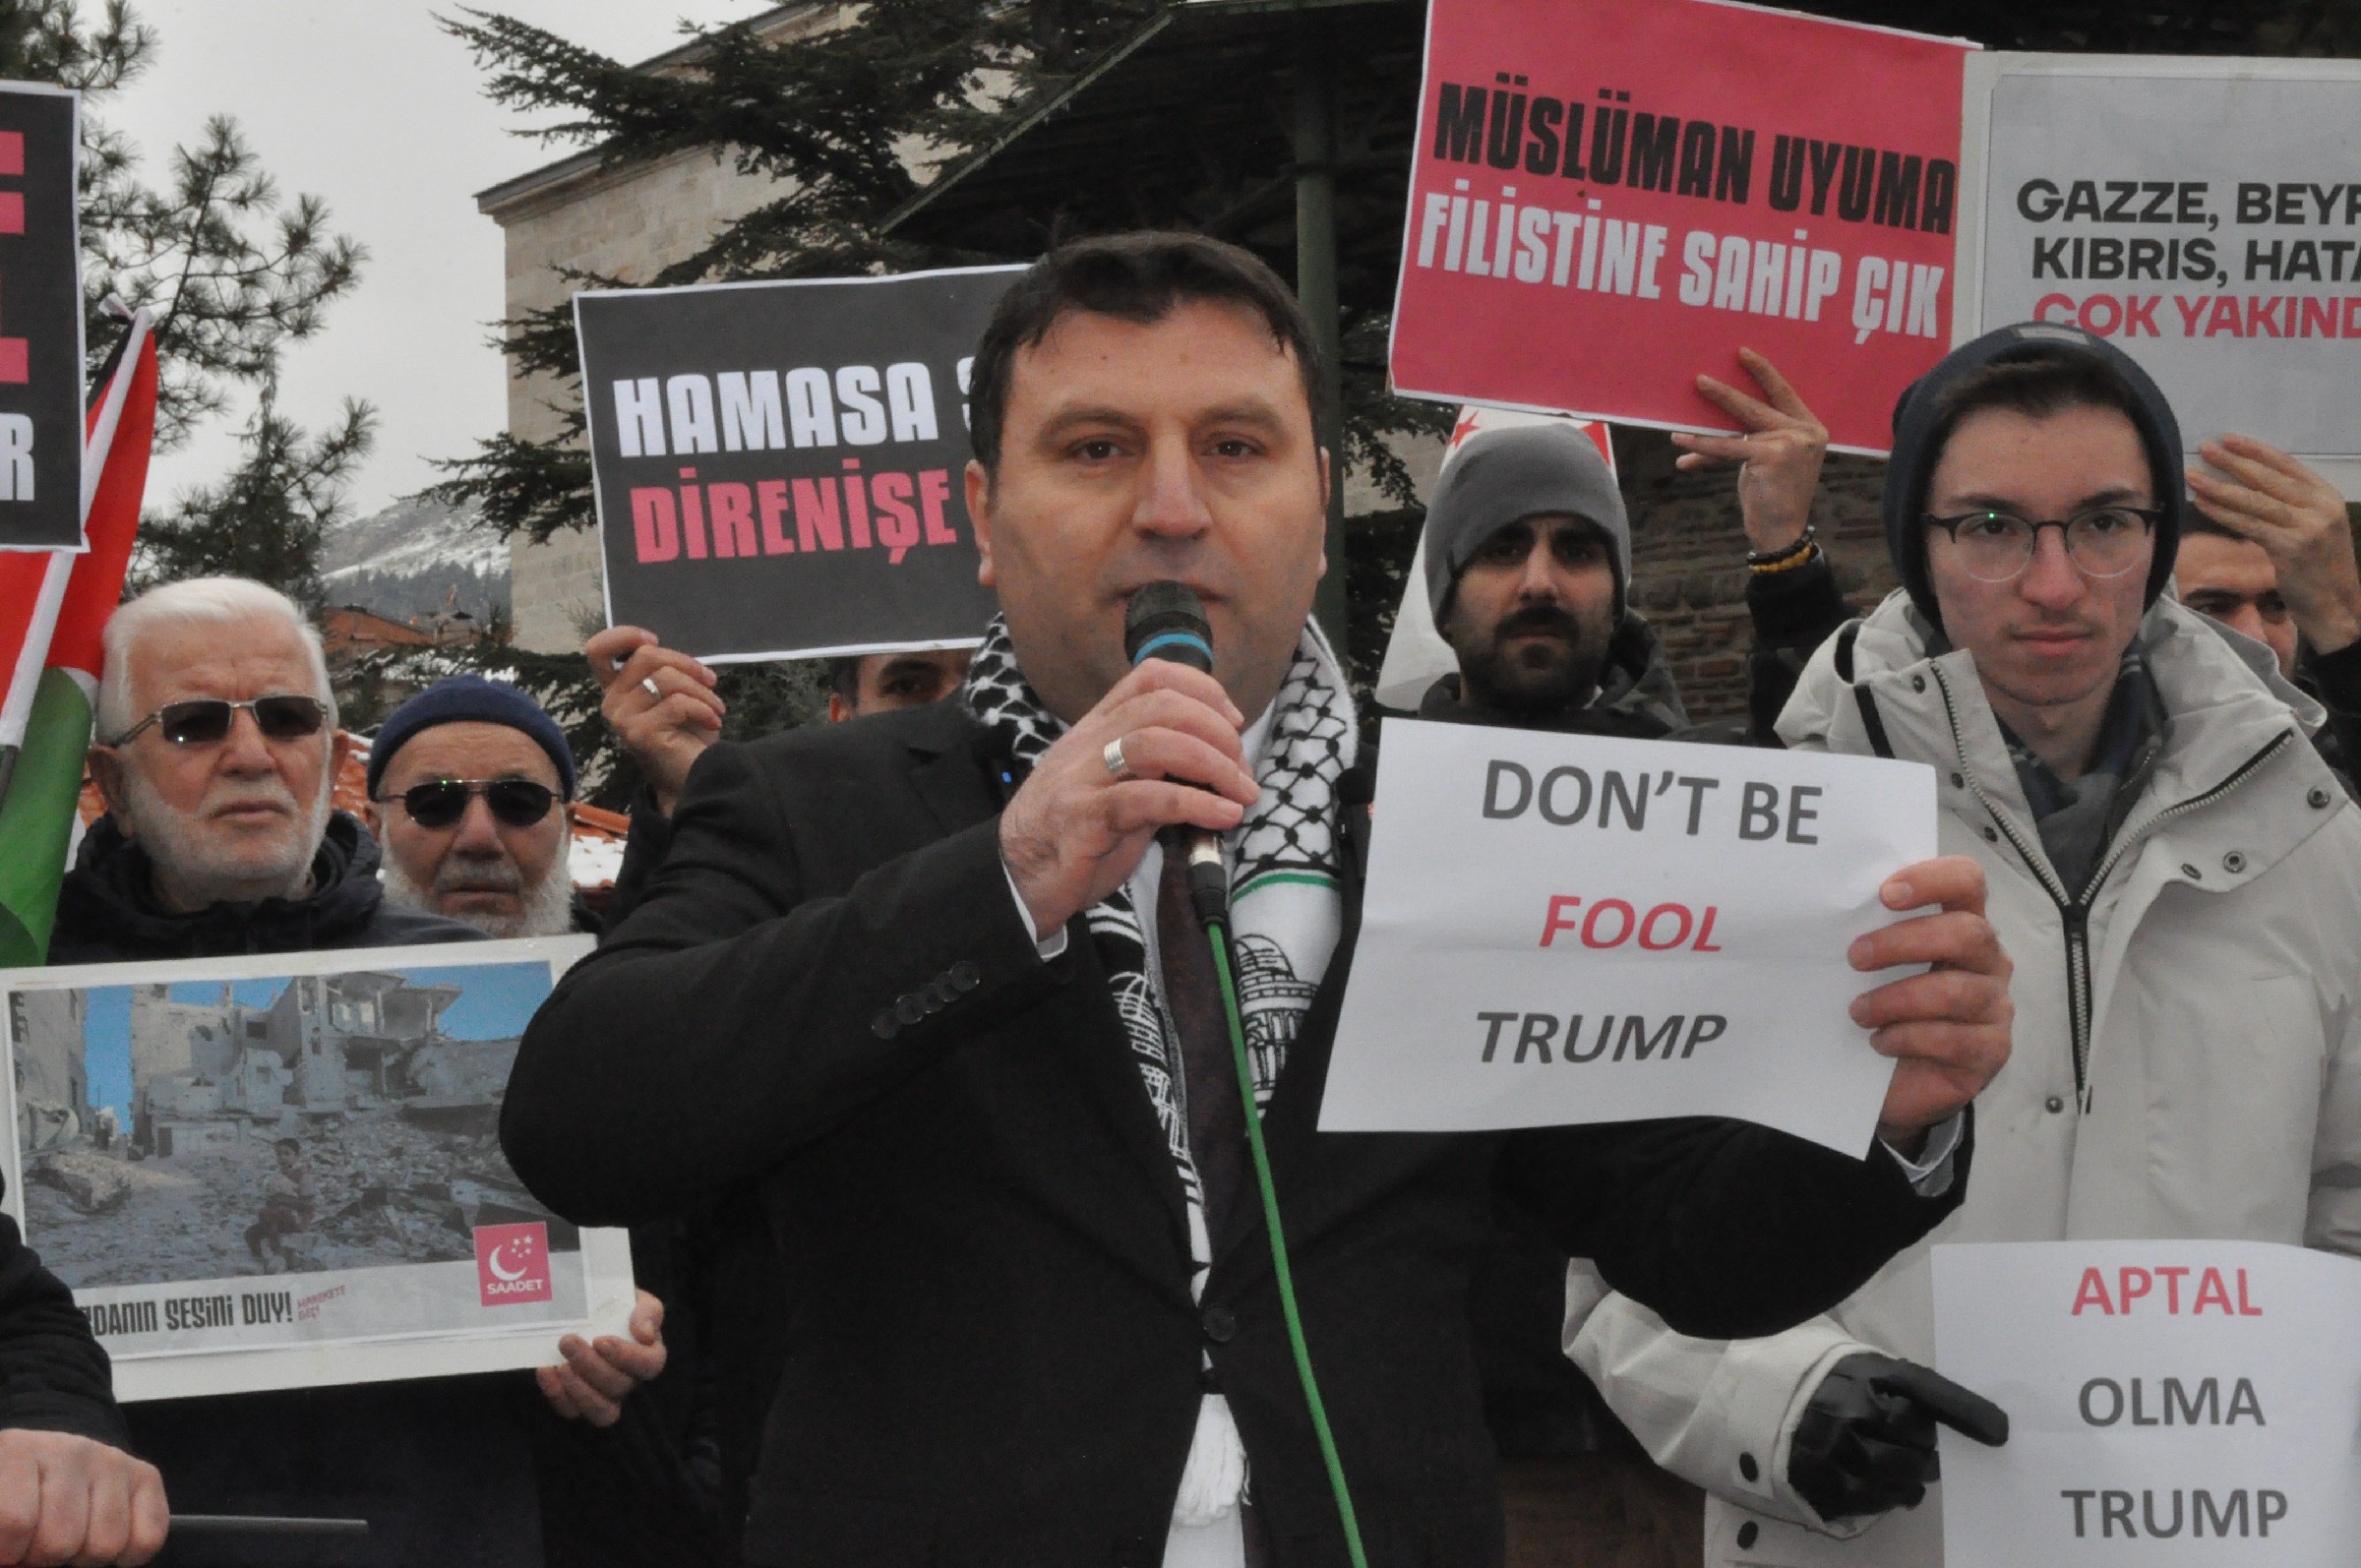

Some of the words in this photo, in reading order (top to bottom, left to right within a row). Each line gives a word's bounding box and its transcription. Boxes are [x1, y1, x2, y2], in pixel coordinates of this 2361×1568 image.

[1433, 72, 1756, 205] MÜSLÜMAN
[1769, 134, 1957, 235] UYUMA
[2017, 178, 2219, 232] GAZZE,
[1417, 178, 1667, 299] FİLİSTİNE
[1679, 228, 1842, 322] SAHİP
[1851, 255, 1945, 345] ÇIK
[2031, 236, 2228, 288] KIBRIS,
[613, 362, 938, 457] HAMASA
[630, 458, 957, 565] DİRENİŞE
[1738, 781, 1823, 845] BE
[1539, 894, 1722, 952] FOOL
[1477, 1011, 1726, 1064] TRUMP
[487, 1279, 543, 1295] SAADET
[2071, 1267, 2263, 1316] APTAL
[81, 1301, 157, 1336] DANIN
[242, 1292, 292, 1325] DUY!
[2079, 1377, 2266, 1426] OLMA
[2061, 1489, 2287, 1538] TRUMP
